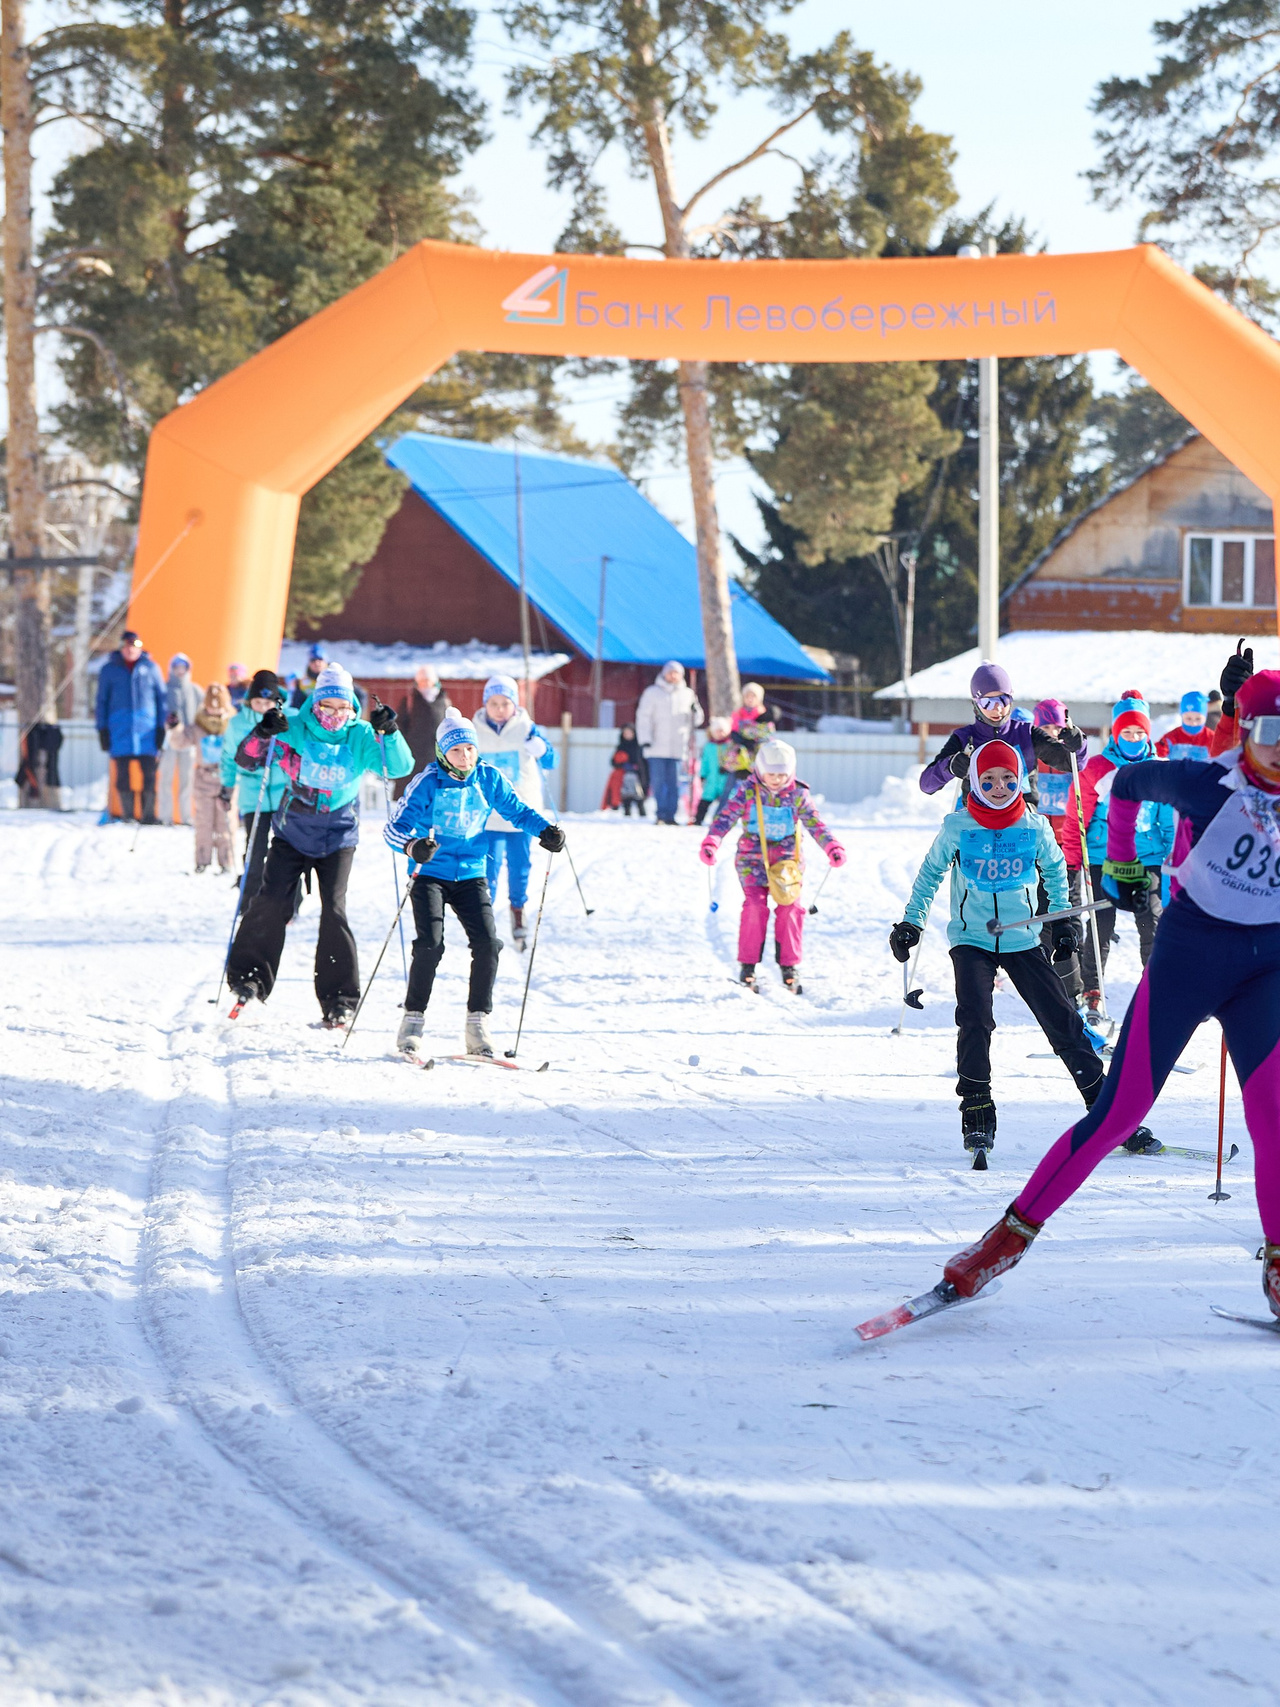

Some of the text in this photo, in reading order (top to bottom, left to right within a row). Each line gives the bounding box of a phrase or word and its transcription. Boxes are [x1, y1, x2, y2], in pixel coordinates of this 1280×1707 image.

[576, 290, 1058, 338] Банк Левобережный
[974, 857, 1024, 880] 7839
[1221, 877, 1273, 897] ОБЛАСТЬ
